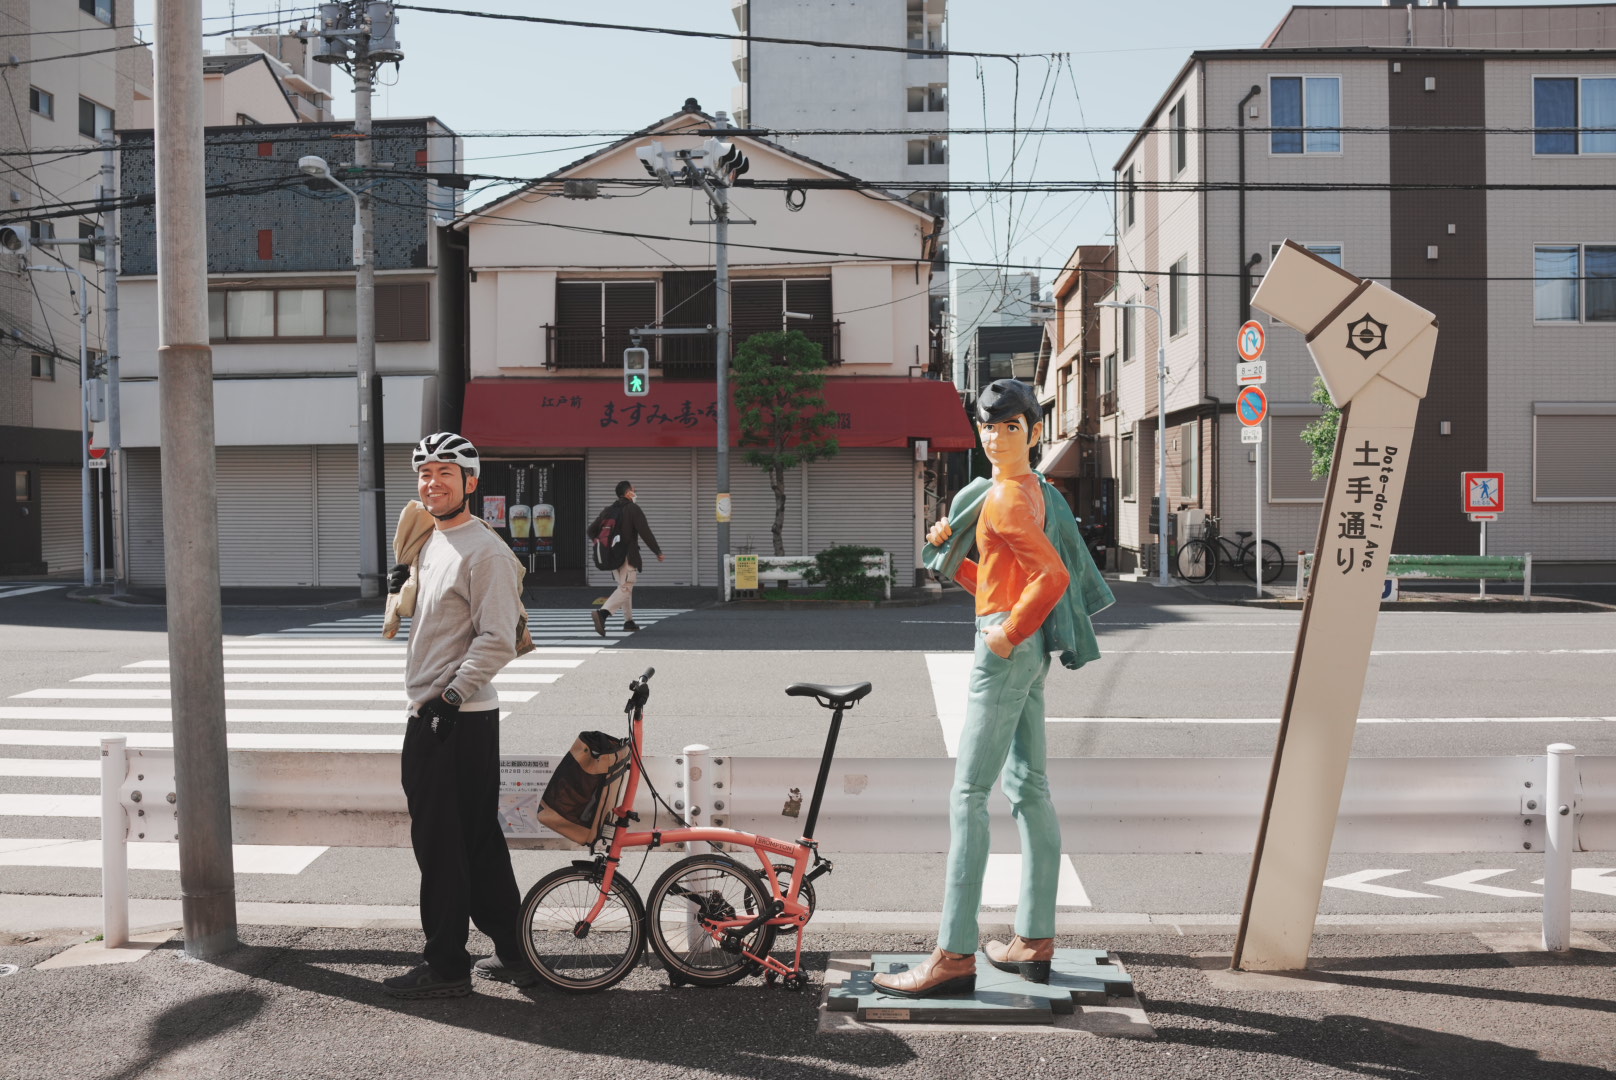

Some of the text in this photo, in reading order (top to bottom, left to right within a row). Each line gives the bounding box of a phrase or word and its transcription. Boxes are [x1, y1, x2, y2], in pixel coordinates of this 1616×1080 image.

[541, 395, 583, 409] 江戸前
[1336, 440, 1380, 575] 土手通り
[1361, 446, 1398, 572] Dote-dori Ave.
[757, 837, 793, 851] BROMPTON
